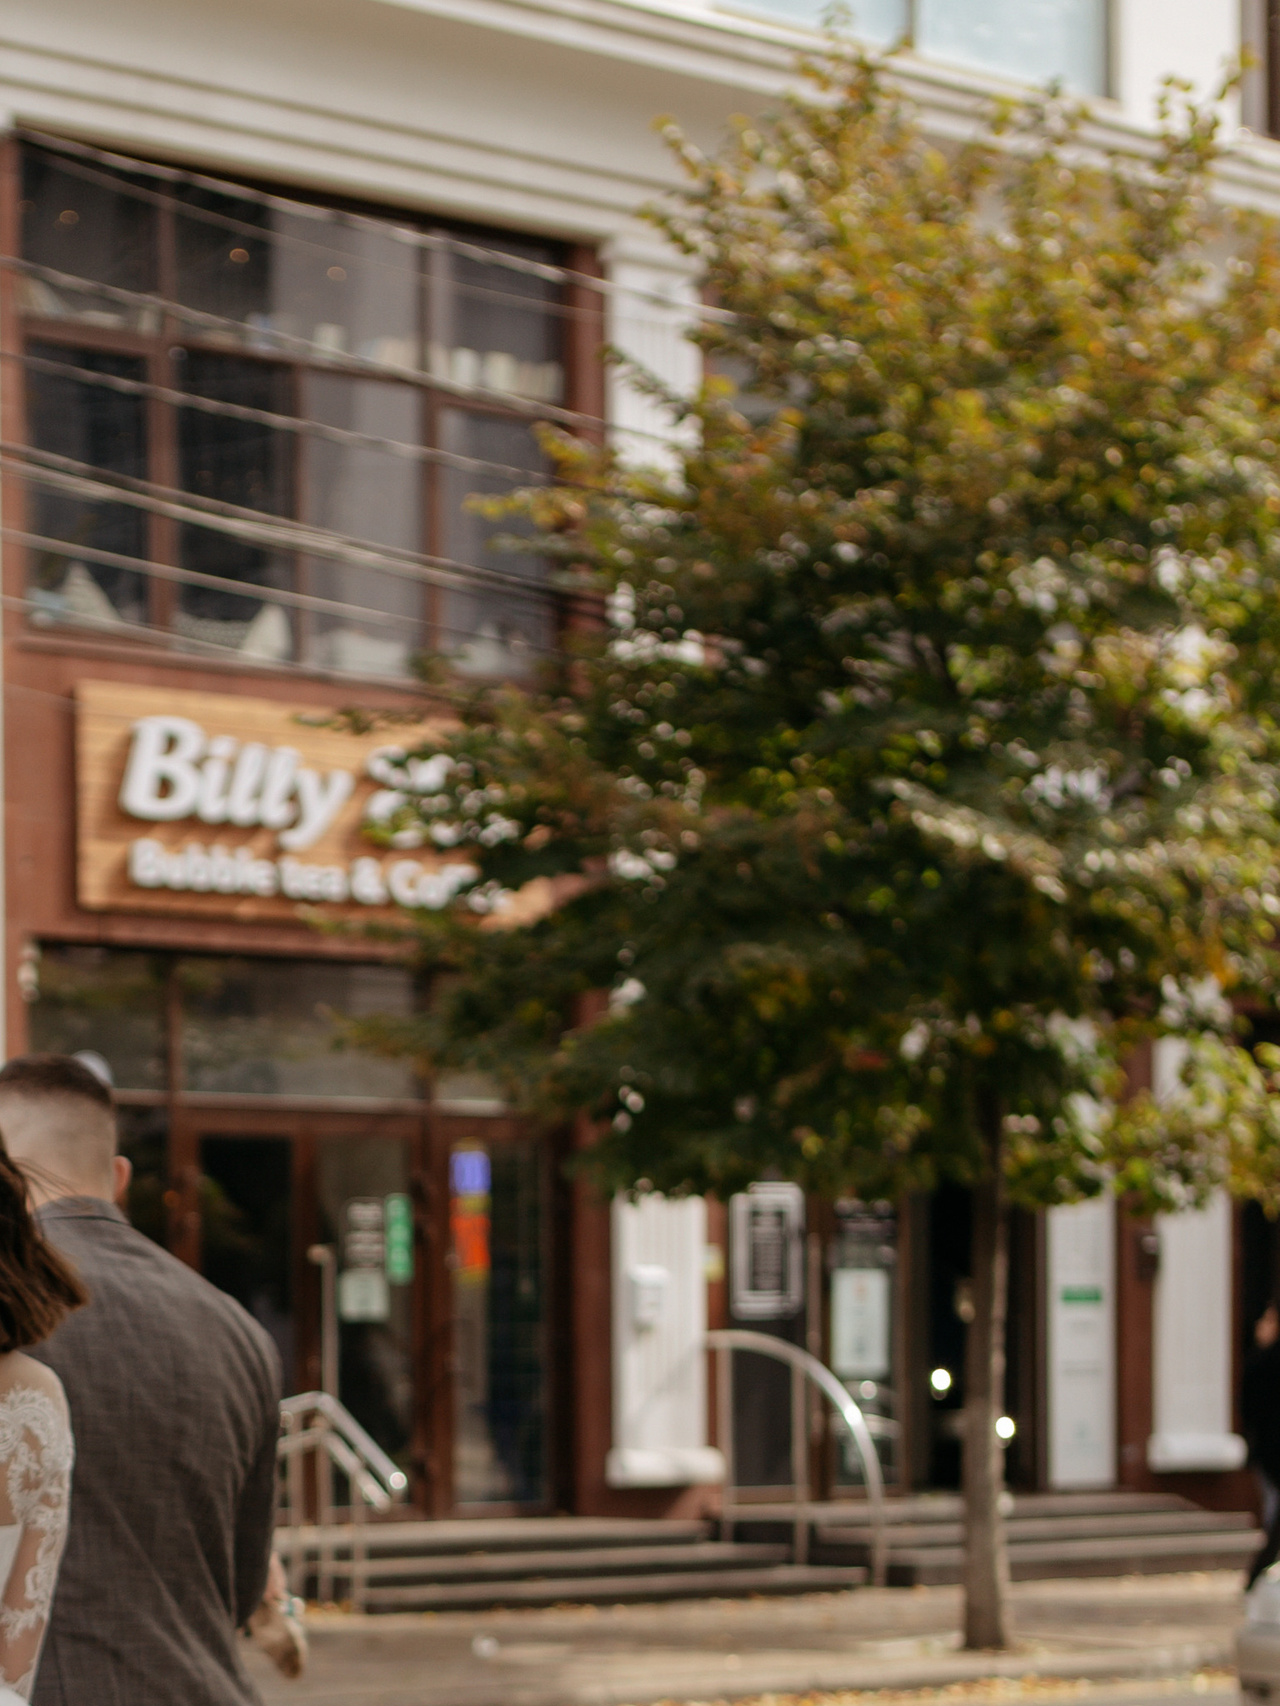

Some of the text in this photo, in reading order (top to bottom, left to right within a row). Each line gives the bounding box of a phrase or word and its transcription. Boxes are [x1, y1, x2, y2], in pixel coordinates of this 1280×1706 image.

[119, 714, 355, 851] Billy
[129, 837, 278, 898] Bubble
[279, 856, 349, 902] tea
[350, 856, 389, 906] &
